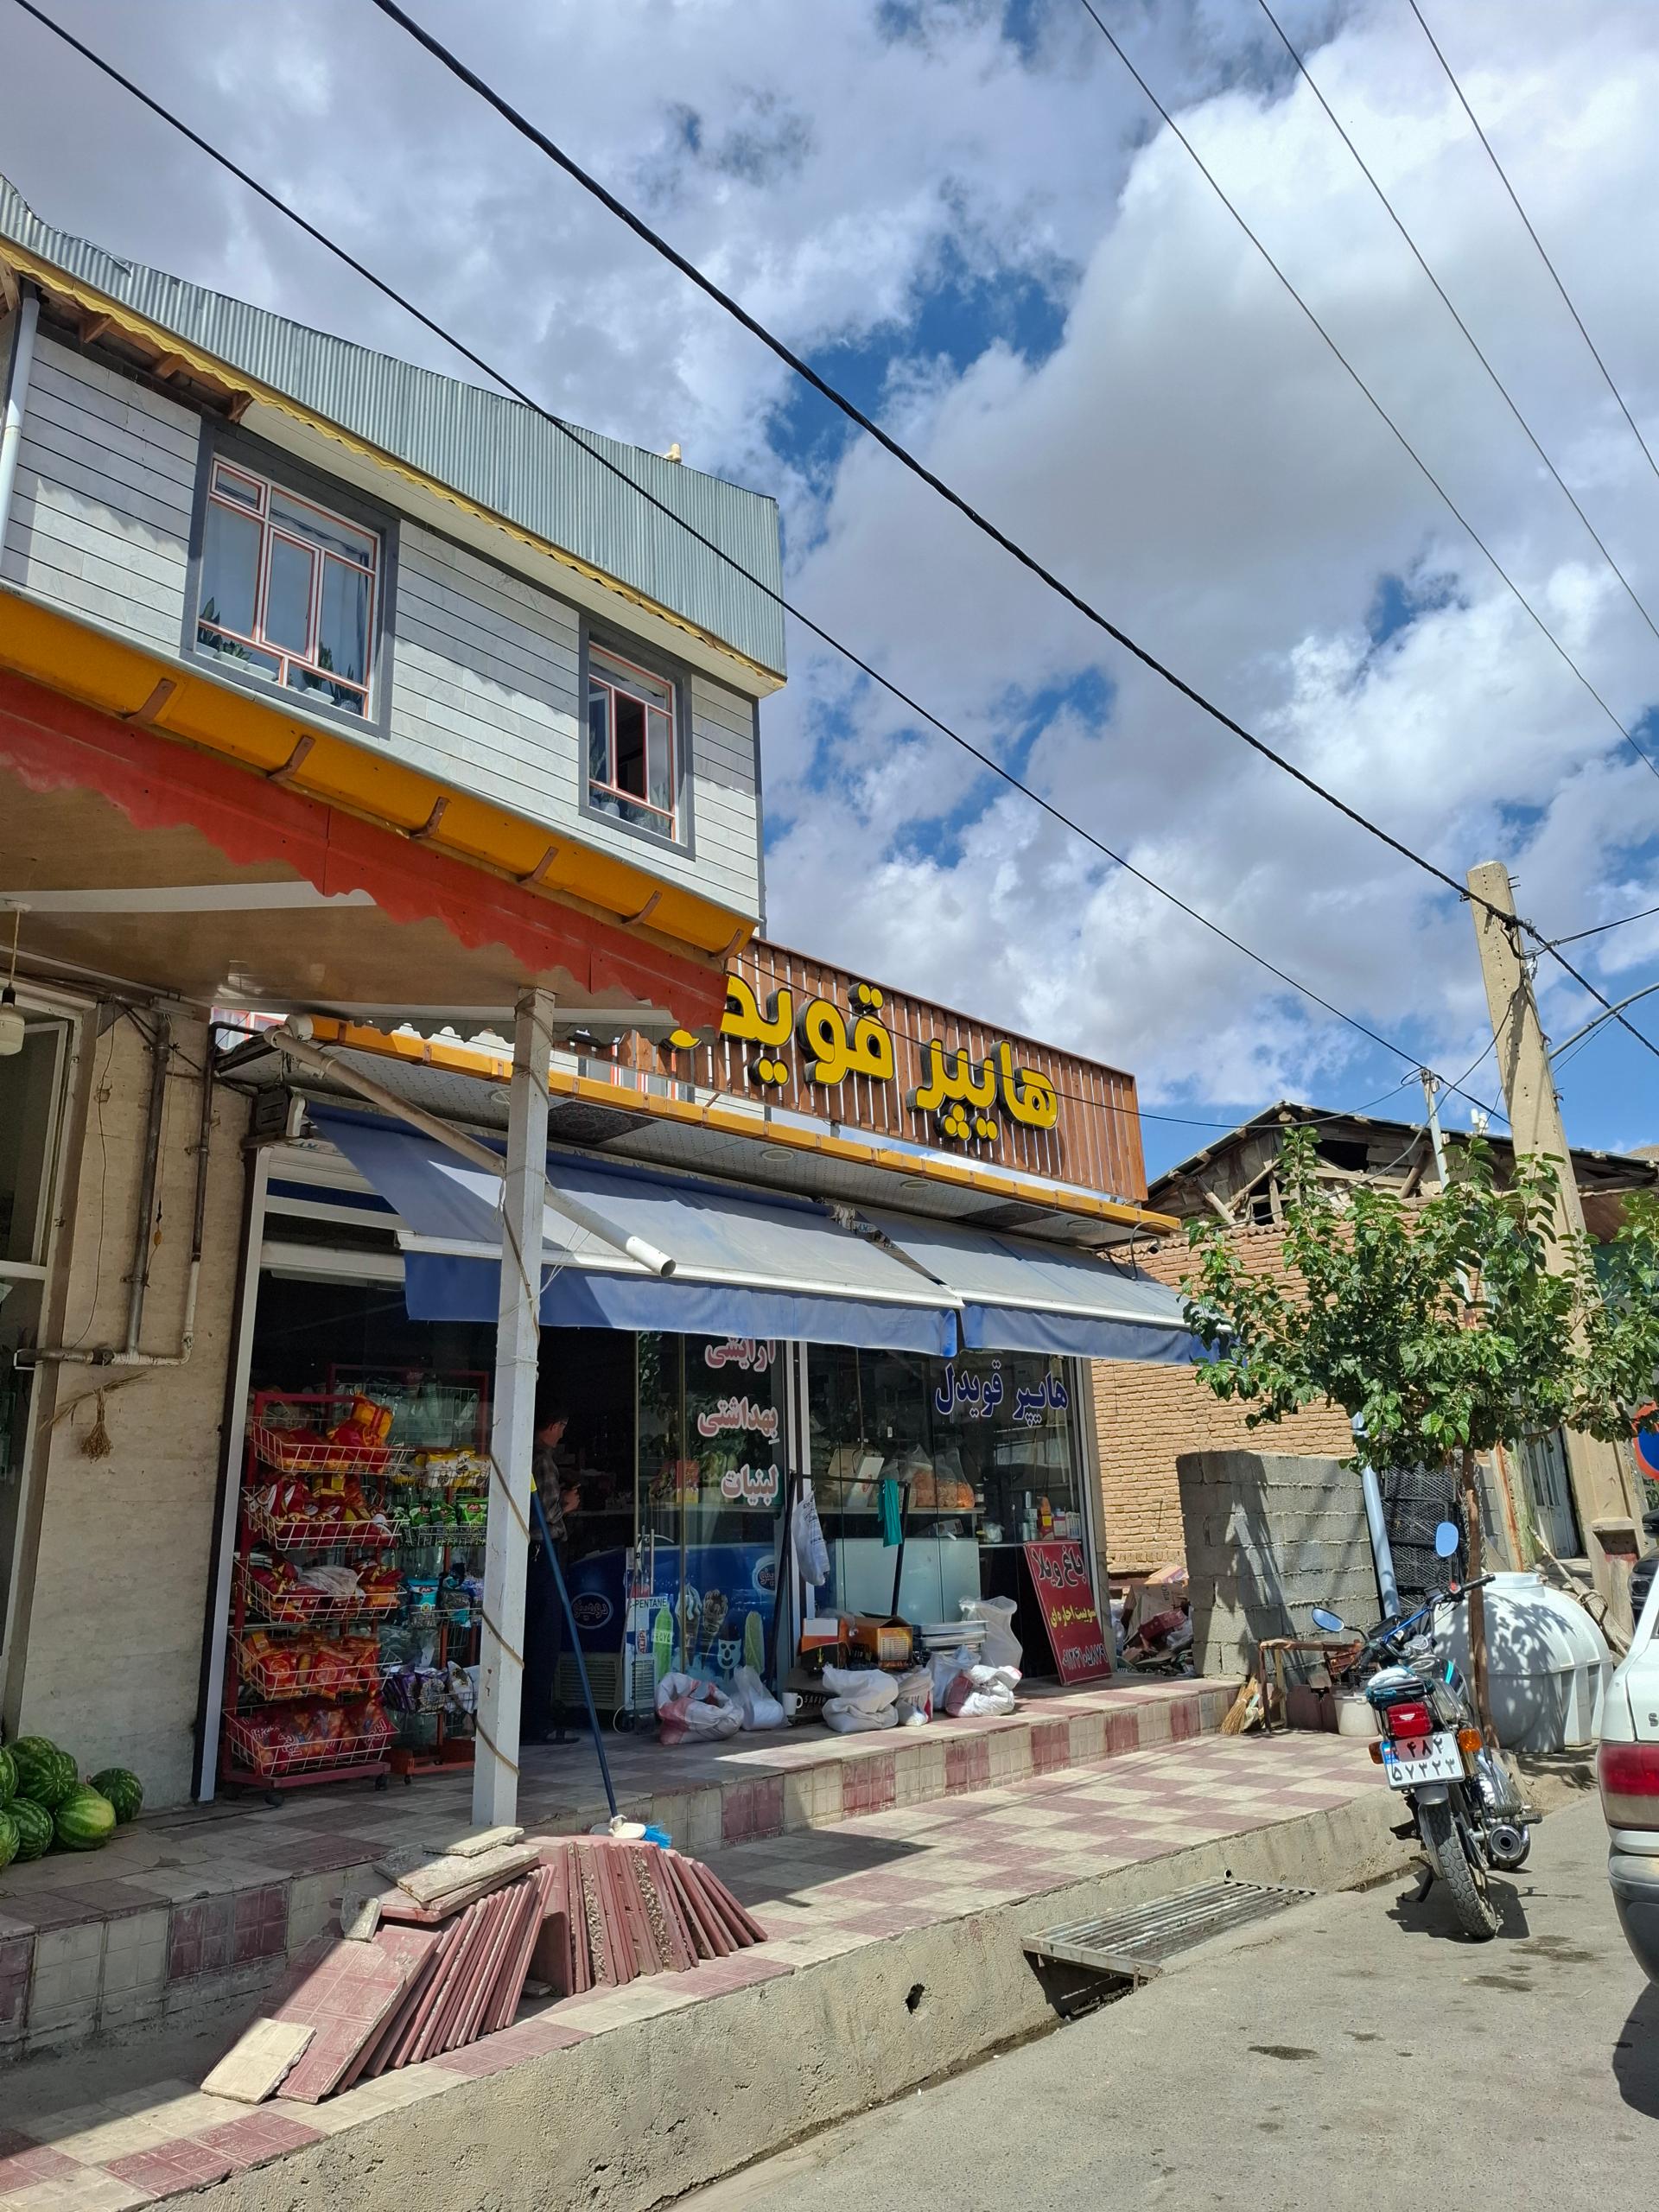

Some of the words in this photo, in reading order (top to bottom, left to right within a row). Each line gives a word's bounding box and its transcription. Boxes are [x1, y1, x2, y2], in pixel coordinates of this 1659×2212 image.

[664, 971, 895, 1087] قوید
[907, 1037, 1059, 1141] هایپر
[936, 1359, 1004, 1419] قویدل
[1013, 1370, 1069, 1427] هایپر
[698, 1396, 779, 1438] بهداشتی
[721, 1464, 779, 1506] لبنیات
[1031, 1547, 1064, 1588] ویلا
[1062, 1545, 1087, 1587] باغ
[628, 1598, 667, 1608] -PENTANE
[1392, 1758, 1455, 1781] ۵۷۳۲۳
